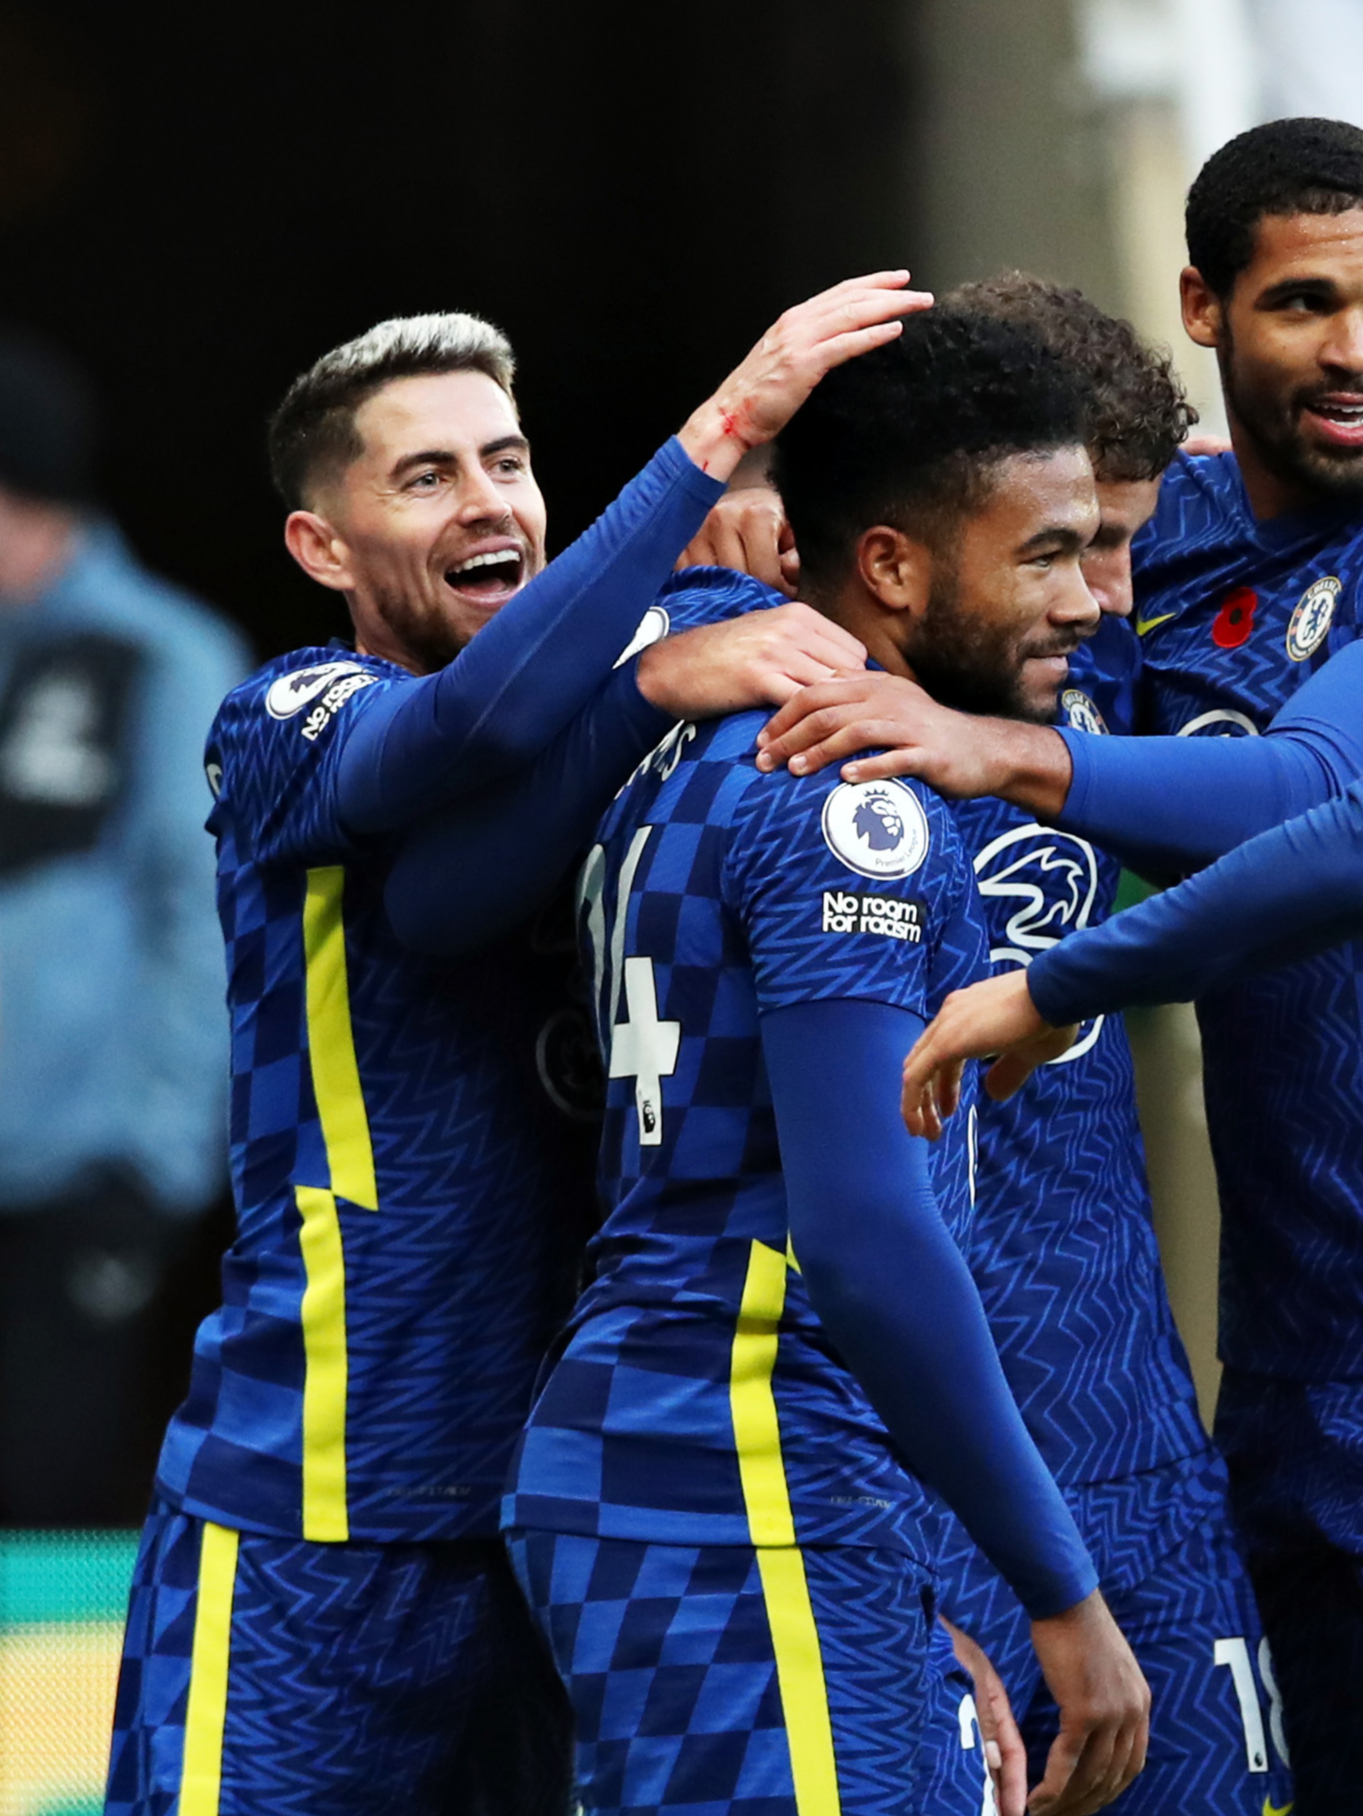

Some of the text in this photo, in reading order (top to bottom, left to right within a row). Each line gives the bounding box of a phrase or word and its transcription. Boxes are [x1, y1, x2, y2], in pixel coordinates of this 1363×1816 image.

[301, 706, 325, 741] No
[823, 891, 917, 923] No room
[823, 911, 858, 932] for
